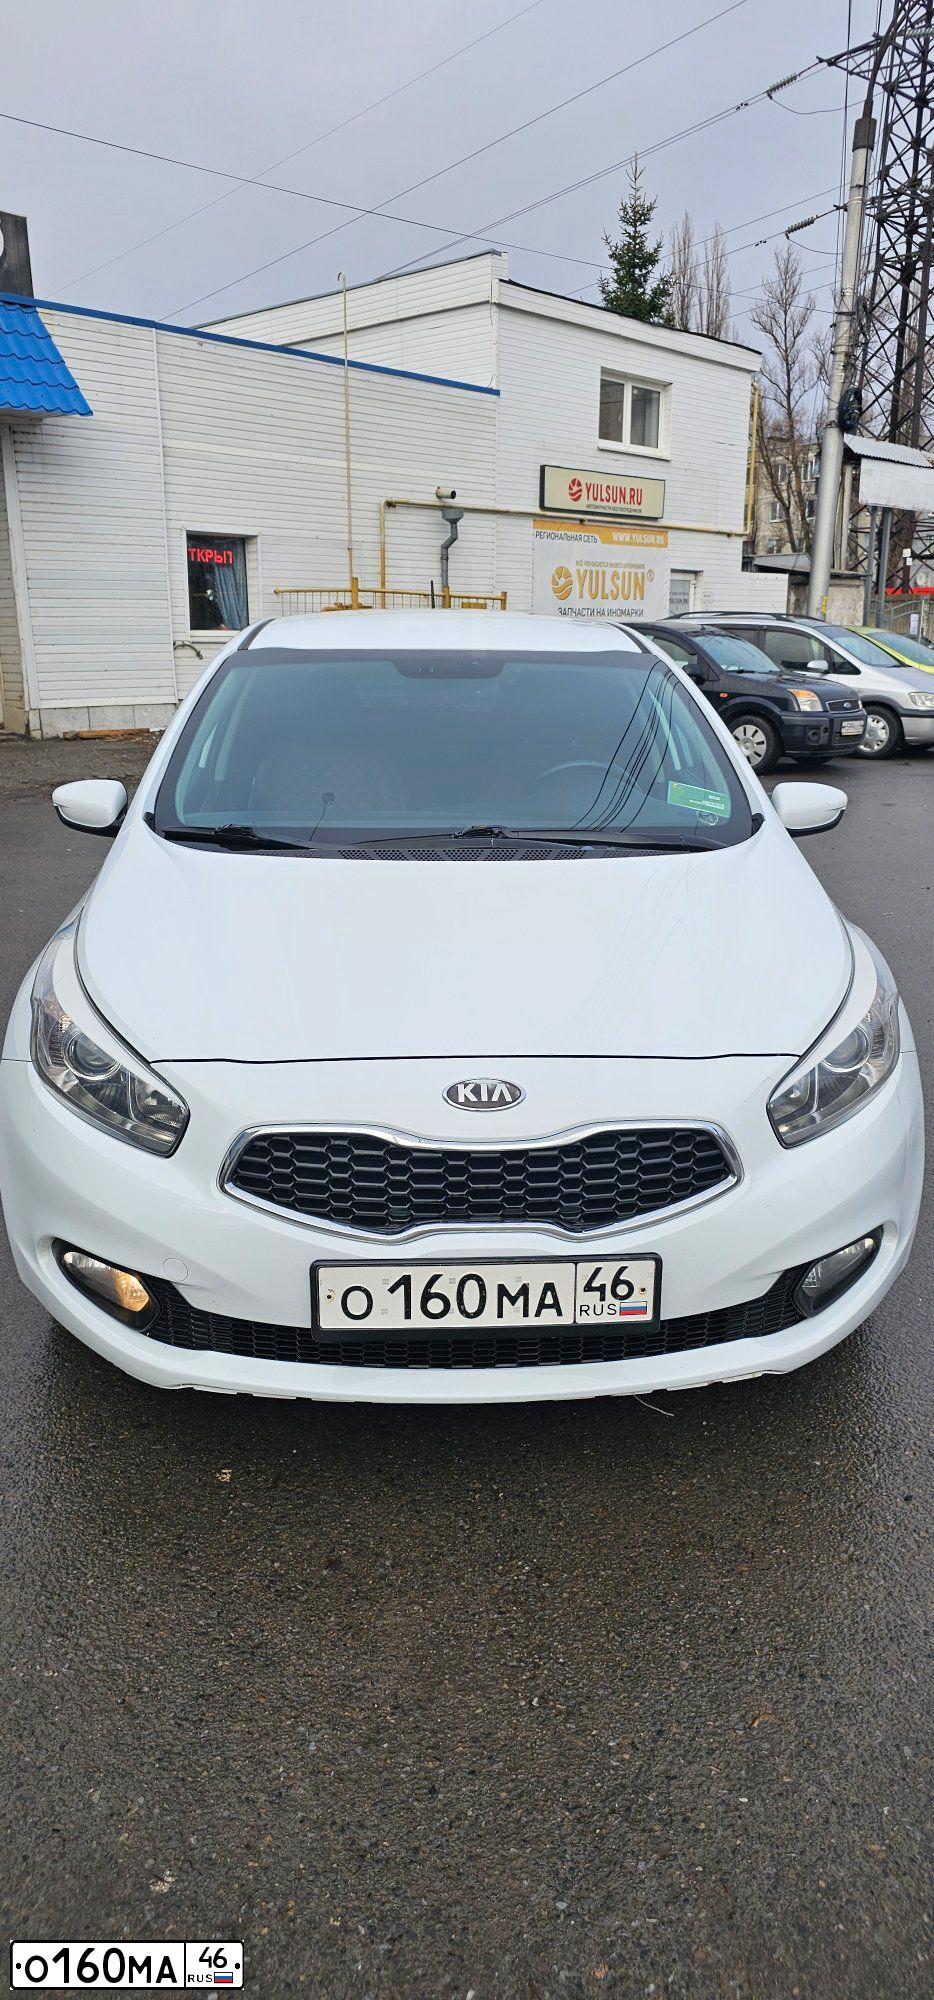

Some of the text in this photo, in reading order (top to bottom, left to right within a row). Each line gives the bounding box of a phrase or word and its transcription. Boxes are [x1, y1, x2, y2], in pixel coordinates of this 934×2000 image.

[585, 482, 643, 506] YULSUN.RU
[535, 530, 598, 543] РЕГИОНАЛЬНАЯ СЕТЬ
[611, 531, 665, 544] WWW.YULSUN.RU
[576, 568, 645, 600] YULSUN
[557, 607, 644, 618] ЗАПЧАСТИ НА ИНОМАРКИ
[456, 1083, 513, 1103] KIA
[583, 1265, 635, 1302] 46
[579, 1304, 617, 1317] RUS
